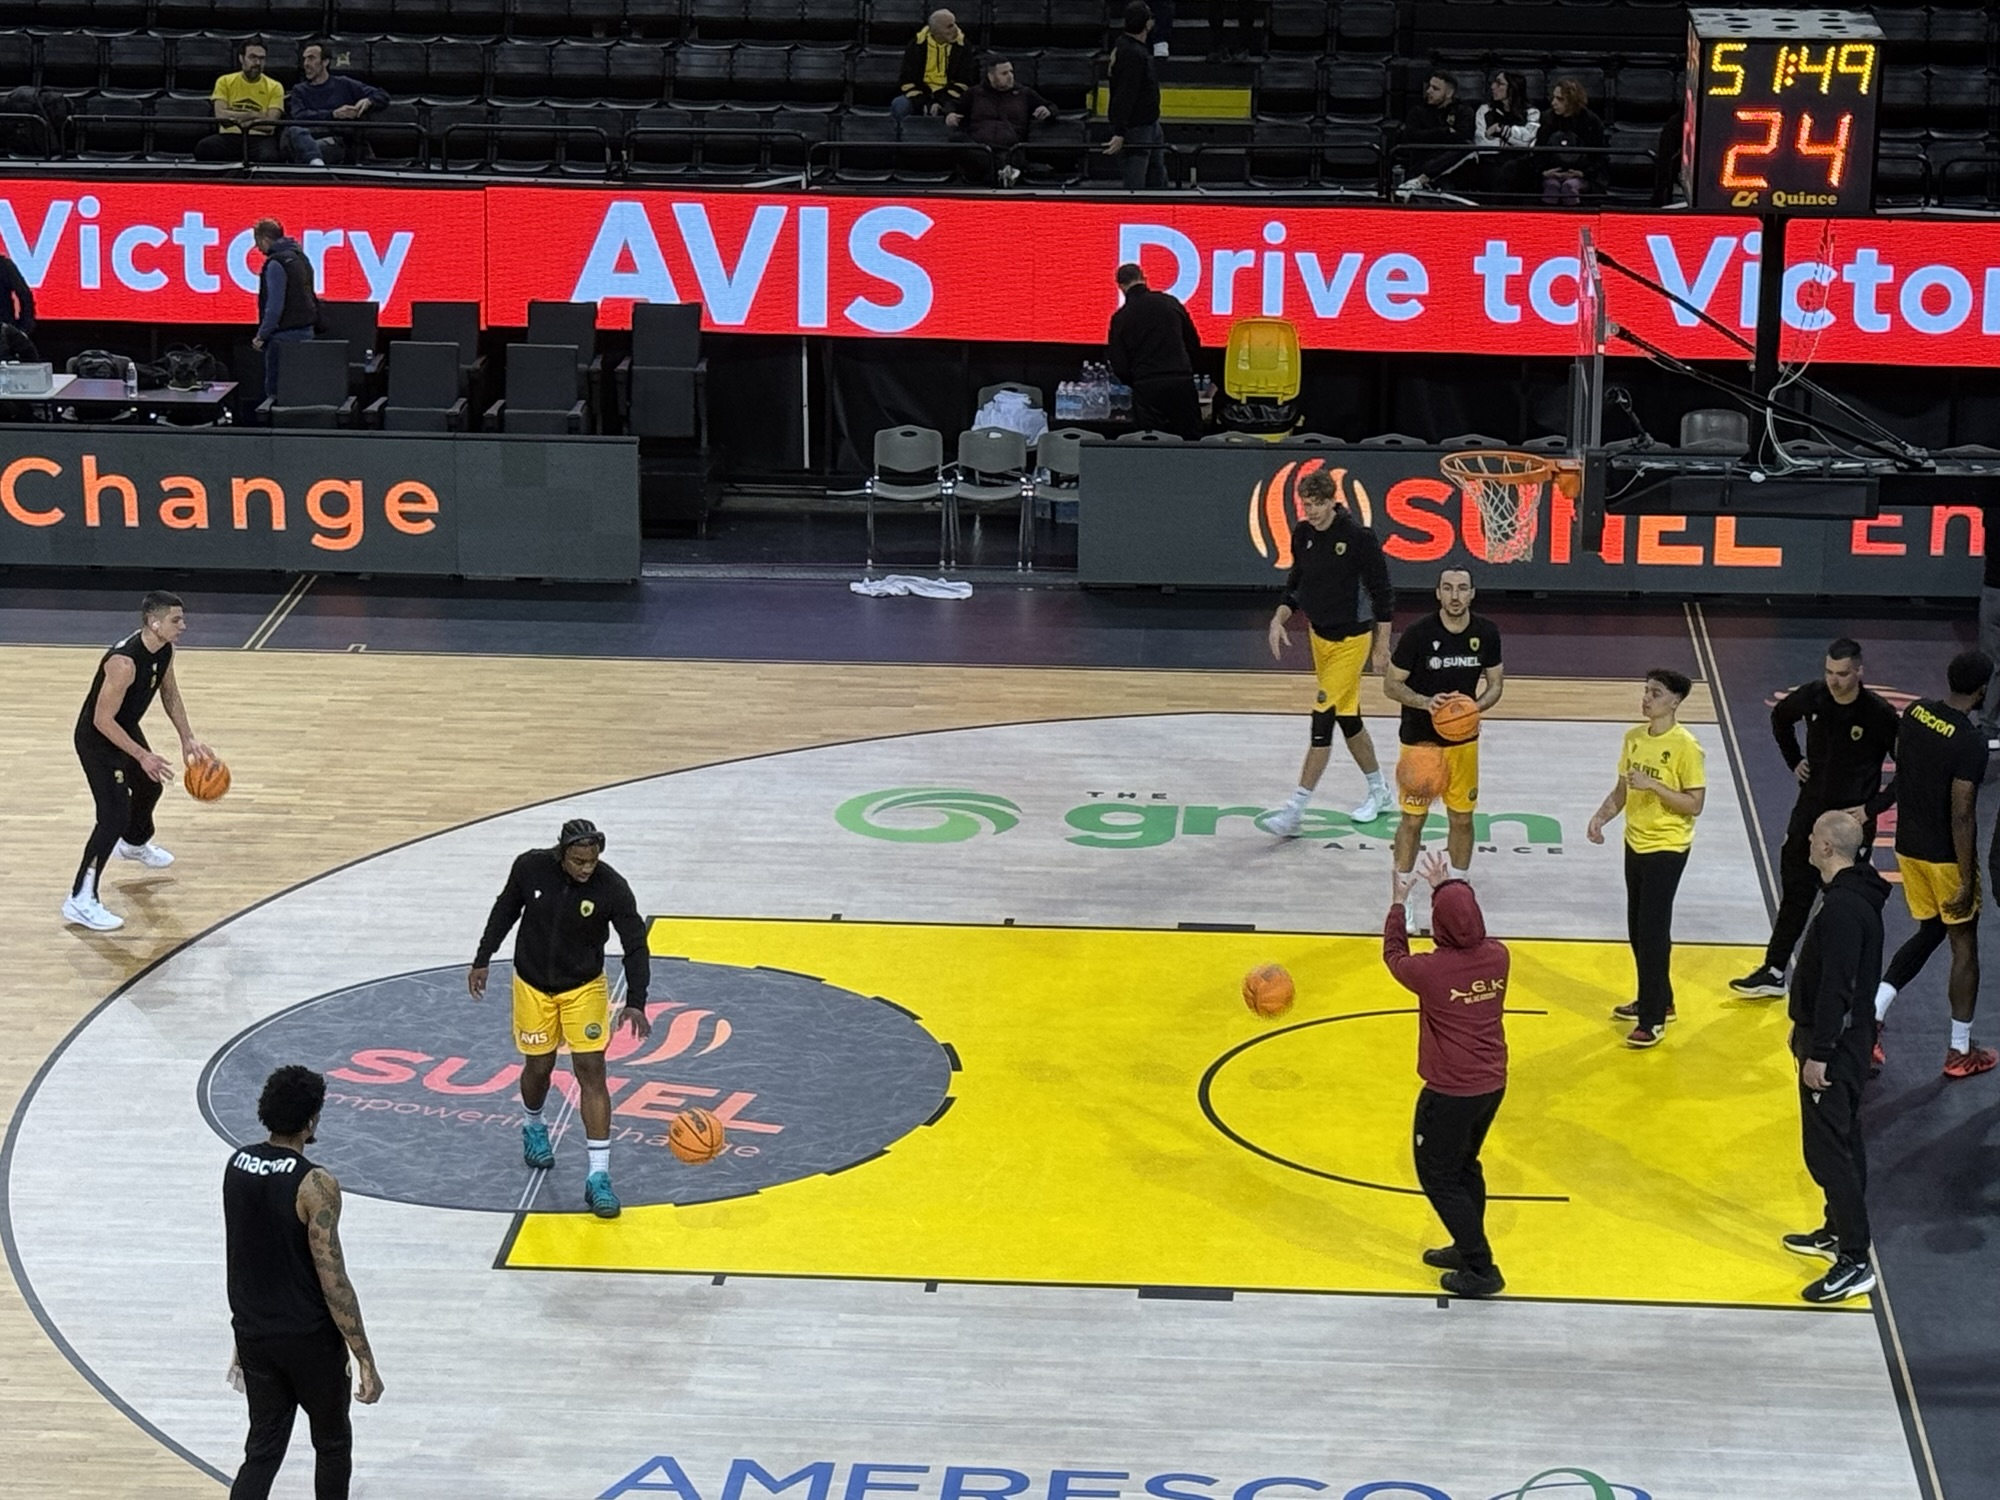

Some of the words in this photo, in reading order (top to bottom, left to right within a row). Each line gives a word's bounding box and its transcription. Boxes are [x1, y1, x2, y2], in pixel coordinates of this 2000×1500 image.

[1708, 43, 1876, 96] 51:49
[1720, 109, 1853, 189] 24
[1772, 191, 1838, 208] Quince
[570, 200, 935, 332] AVIS
[1118, 220, 1430, 321] Drive
[1474, 240, 1581, 325] to
[0, 454, 440, 551] Change
[1443, 656, 1482, 668] SUNEL
[1910, 704, 1956, 738] macron
[1086, 791, 1168, 800] THE
[520, 1032, 548, 1045] AVIS
